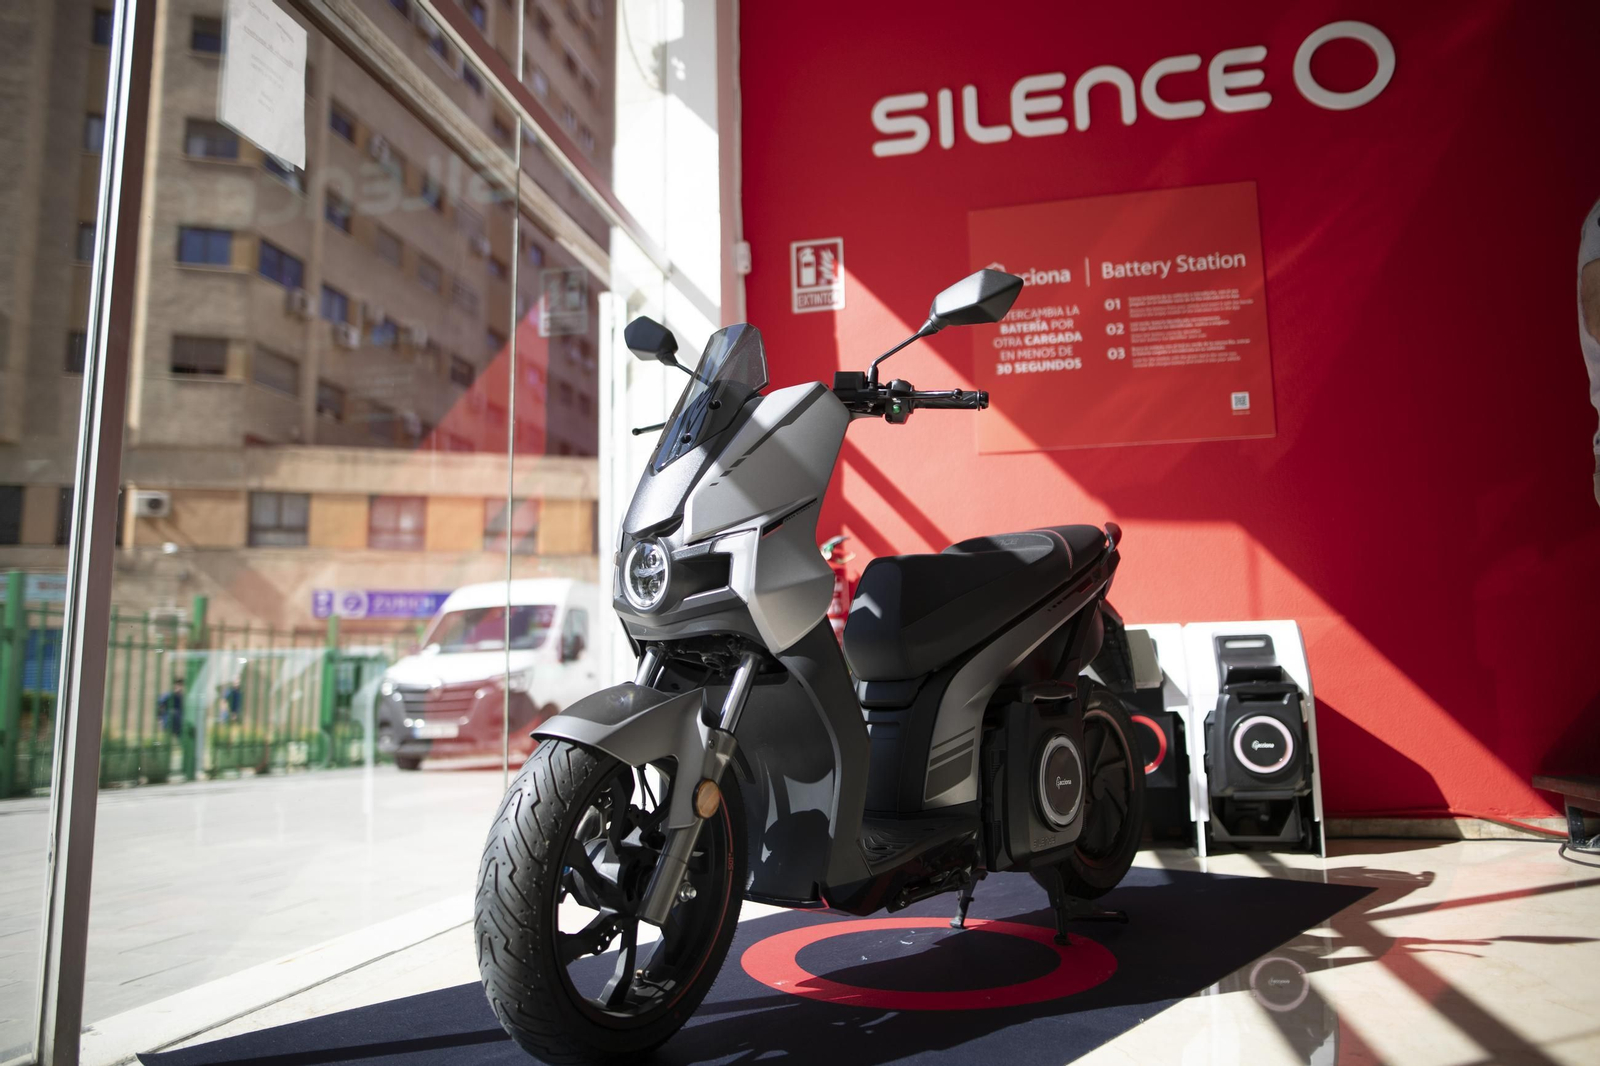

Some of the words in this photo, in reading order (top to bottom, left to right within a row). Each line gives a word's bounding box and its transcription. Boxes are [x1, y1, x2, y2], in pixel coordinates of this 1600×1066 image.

[871, 45, 1272, 157] SILENCE
[1102, 259, 1171, 280] Battery
[1176, 252, 1246, 273] Station
[1013, 267, 1071, 286] ciona
[798, 293, 839, 306] EXTINTO
[1104, 299, 1121, 311] 01
[1002, 306, 1064, 321] TERCAMBIA
[1066, 304, 1080, 316] LA
[1000, 319, 1049, 335] BATERÍA
[1051, 318, 1075, 330] POR
[1106, 323, 1125, 336] 02
[993, 336, 1022, 349] OTRA
[1024, 331, 1083, 346] CARGADA
[1001, 350, 1015, 362] EN
[1018, 346, 1056, 360] MENOS
[1058, 345, 1074, 357] DE
[1107, 347, 1126, 360] 03
[996, 362, 1012, 375] 30
[1014, 357, 1082, 373] SEGUNDOS
